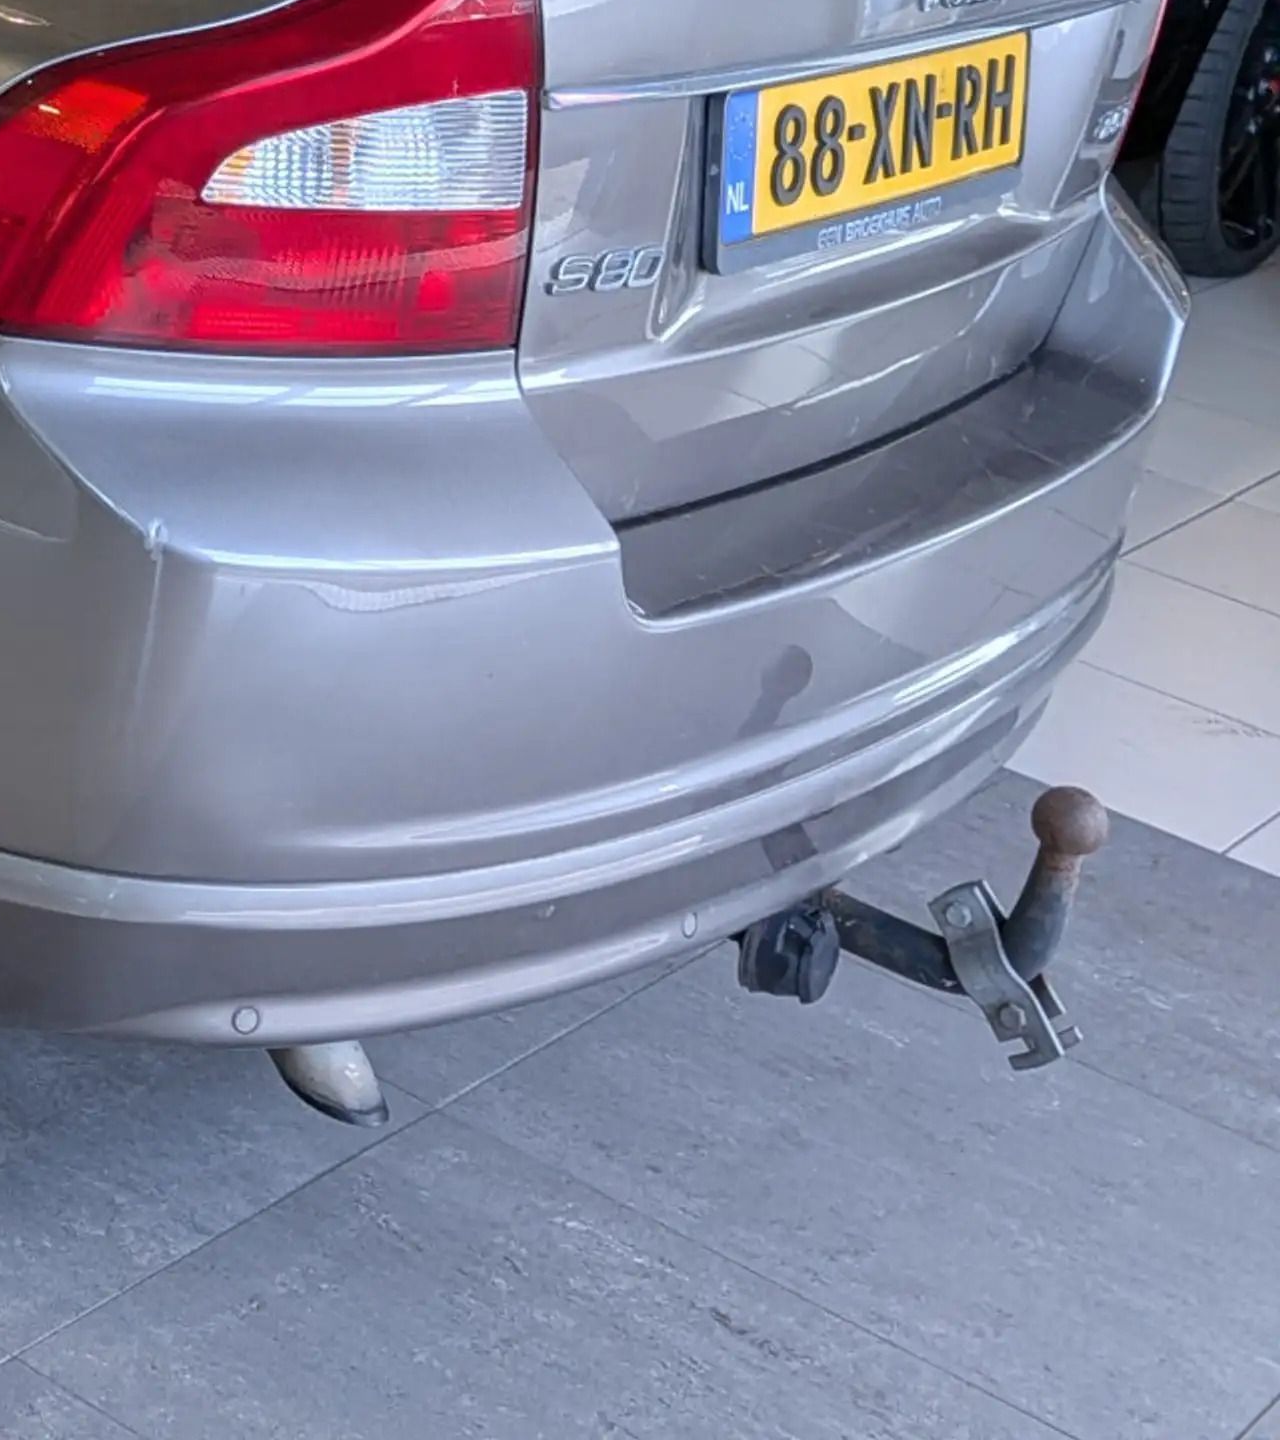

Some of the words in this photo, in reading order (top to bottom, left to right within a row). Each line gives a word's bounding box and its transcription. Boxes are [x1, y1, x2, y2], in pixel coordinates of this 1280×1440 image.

[770, 54, 1016, 206] 88-XN-RH
[726, 180, 750, 215] NL
[544, 242, 664, 295] S80
